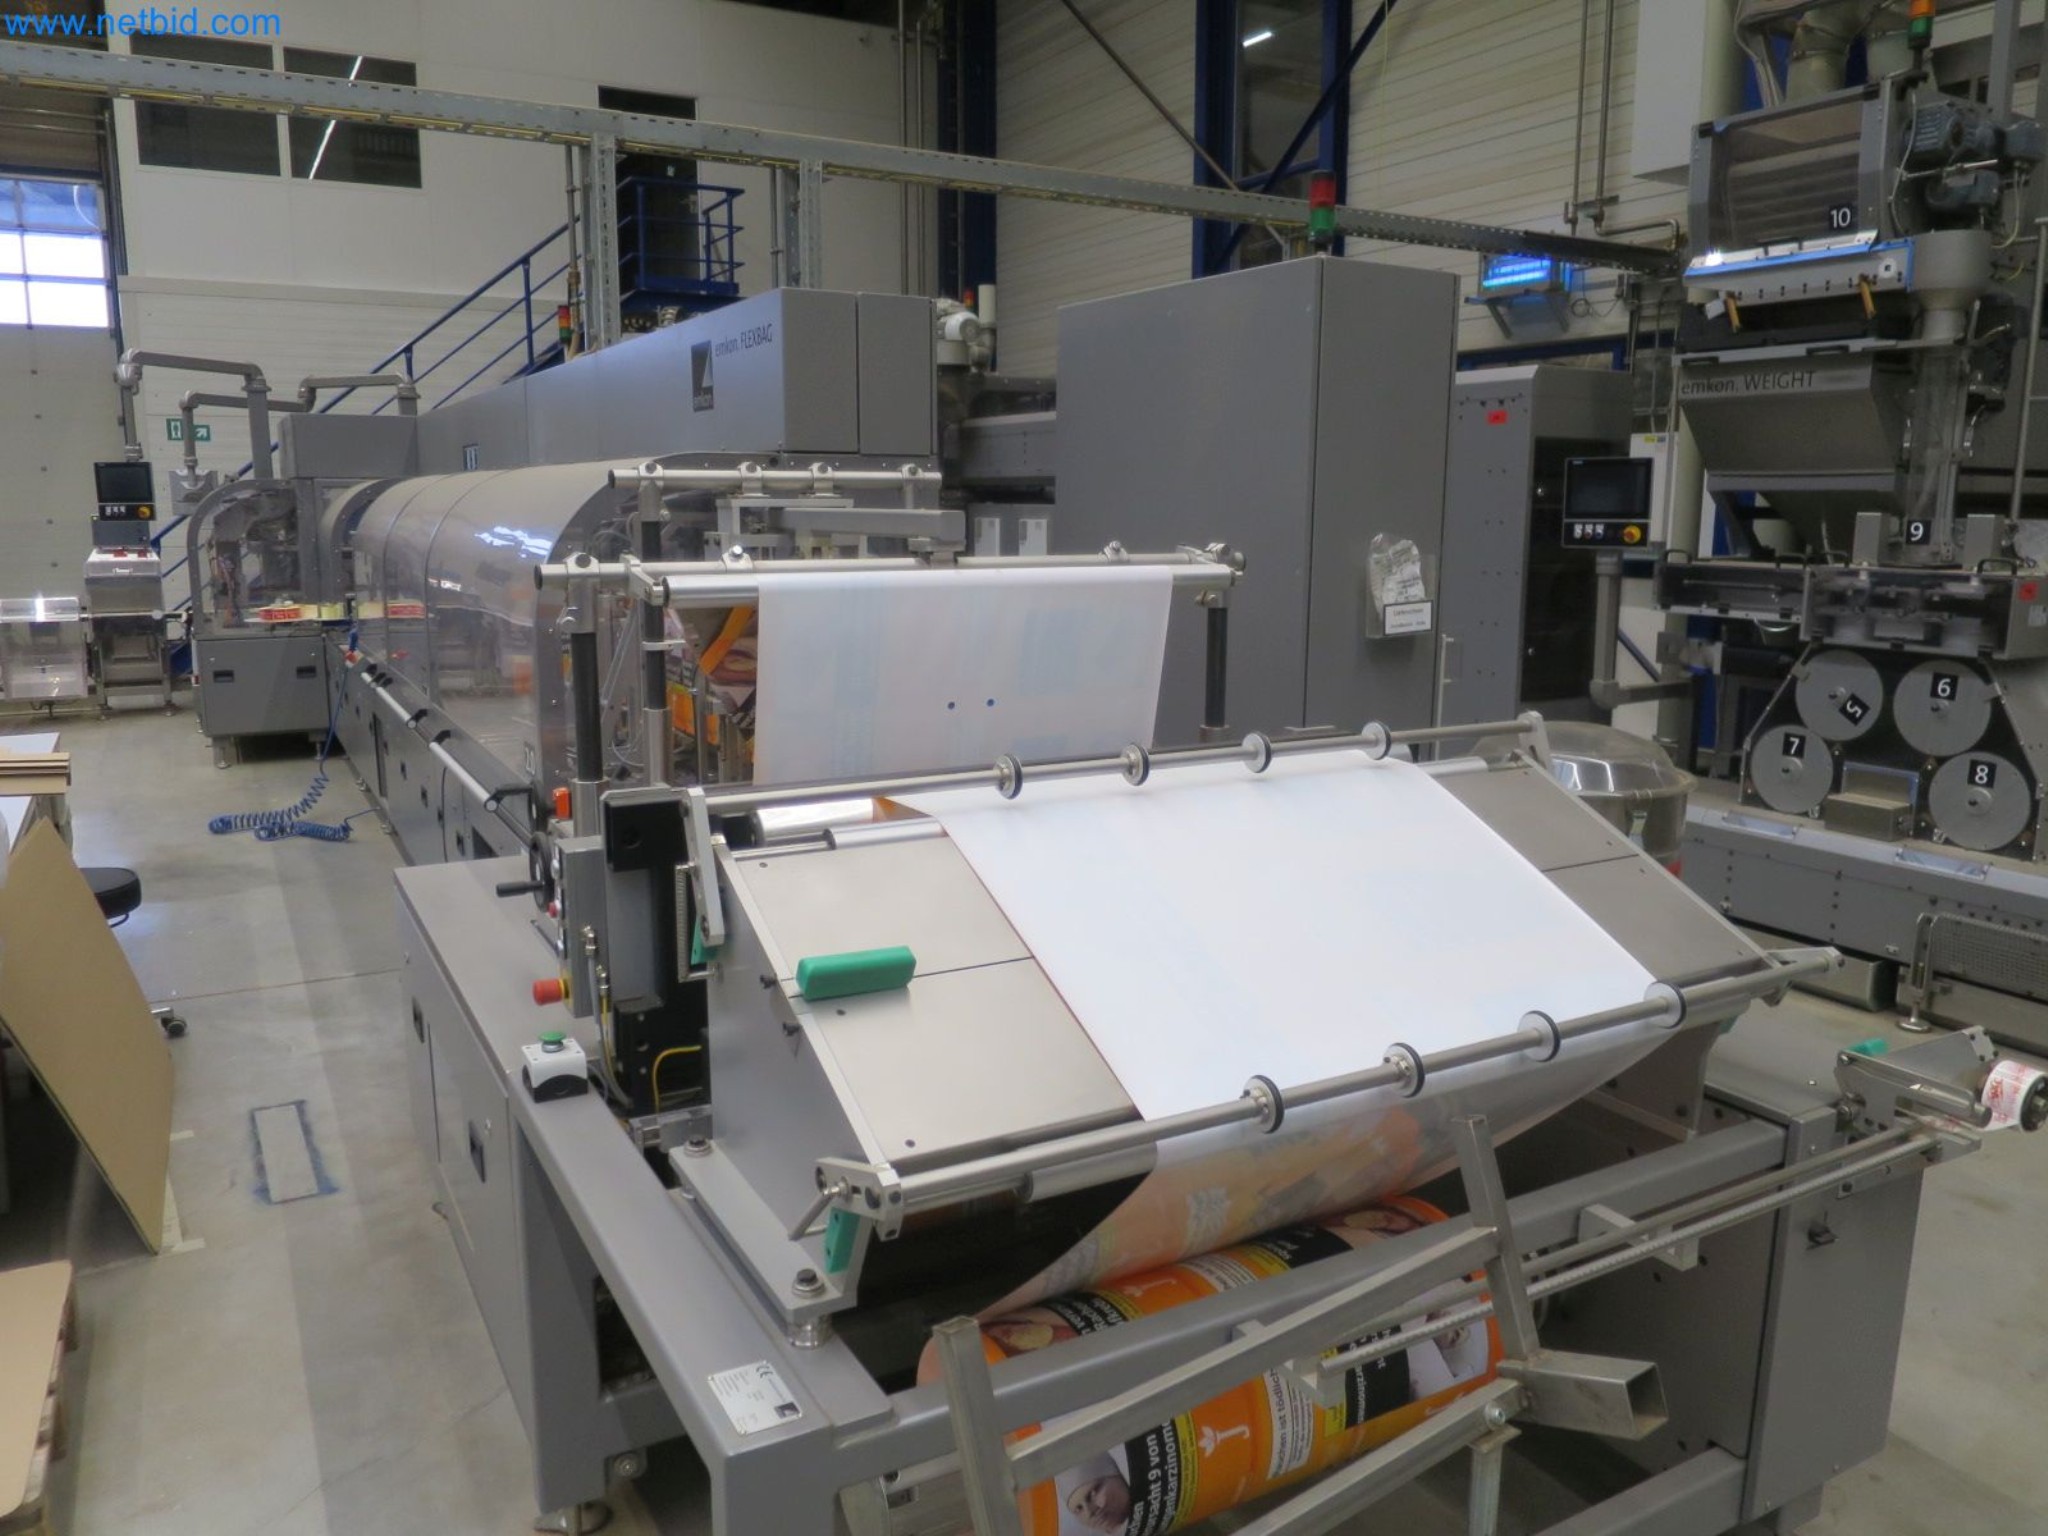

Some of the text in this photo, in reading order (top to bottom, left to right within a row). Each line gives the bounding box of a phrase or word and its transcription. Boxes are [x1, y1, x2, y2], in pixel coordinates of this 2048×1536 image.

[1830, 207, 1851, 229] 10
[740, 323, 773, 350] FLEXBAG
[1742, 370, 1817, 391] WEIGHT
[1910, 521, 1924, 541] 9
[1937, 678, 1951, 698] 6
[1846, 701, 1862, 718] 5
[1789, 736, 1800, 755] 7
[1974, 764, 1989, 784] 8
[1146, 1434, 1162, 1465] von
[1148, 1468, 1161, 1481] 9
